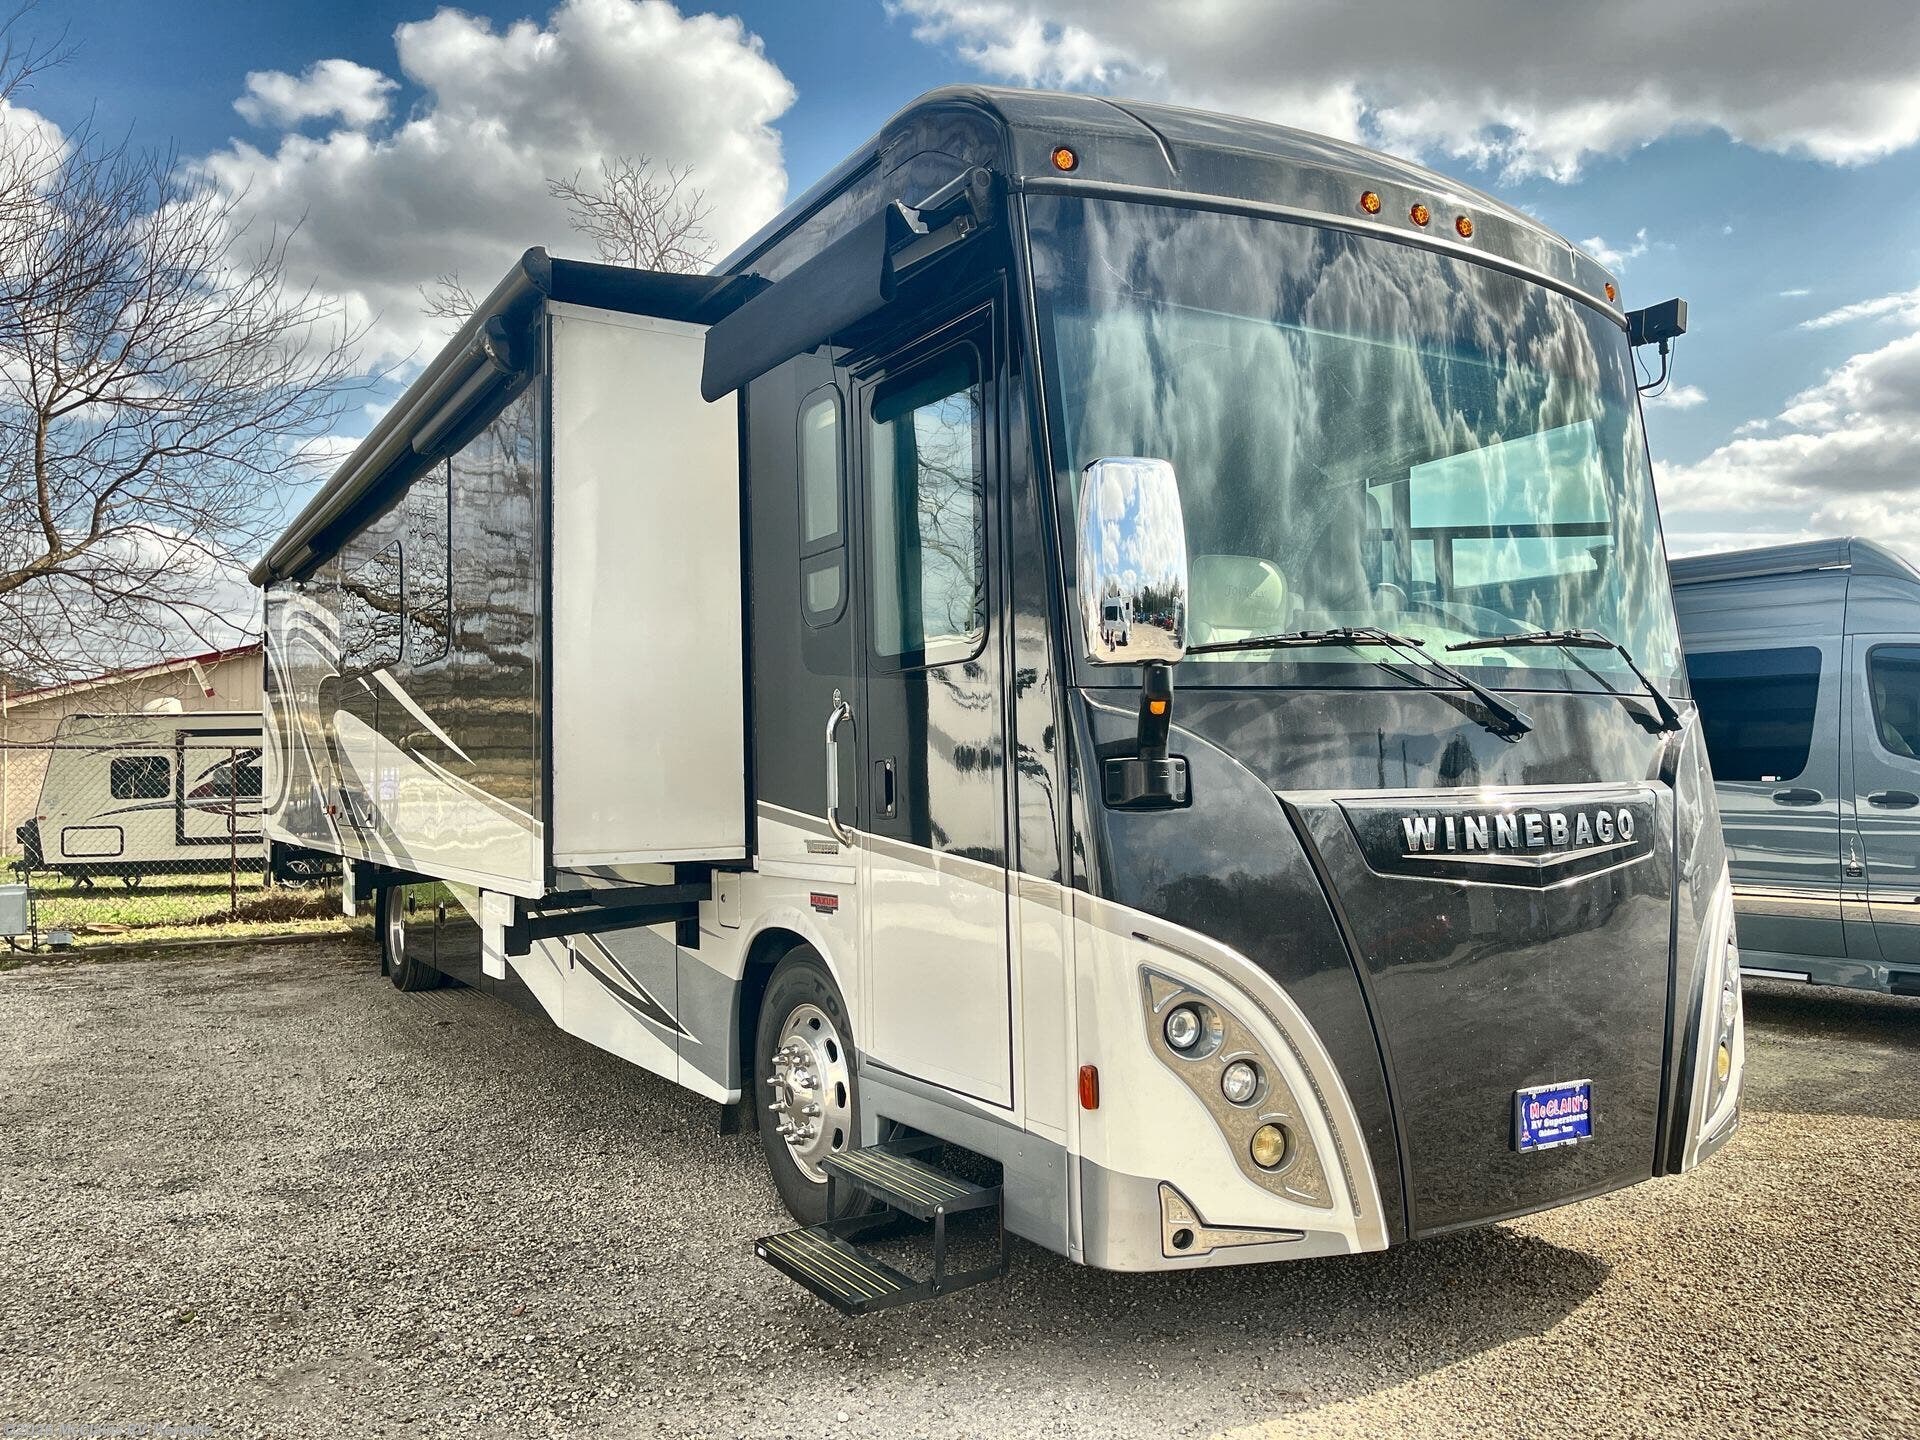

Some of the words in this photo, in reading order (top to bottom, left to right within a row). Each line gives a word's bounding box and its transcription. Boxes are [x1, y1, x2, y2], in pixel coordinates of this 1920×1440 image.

[1401, 808, 1635, 852] WINNEBAGO
[1531, 1119, 1543, 1130] RV
[1543, 1113, 1588, 1128] Superstores
